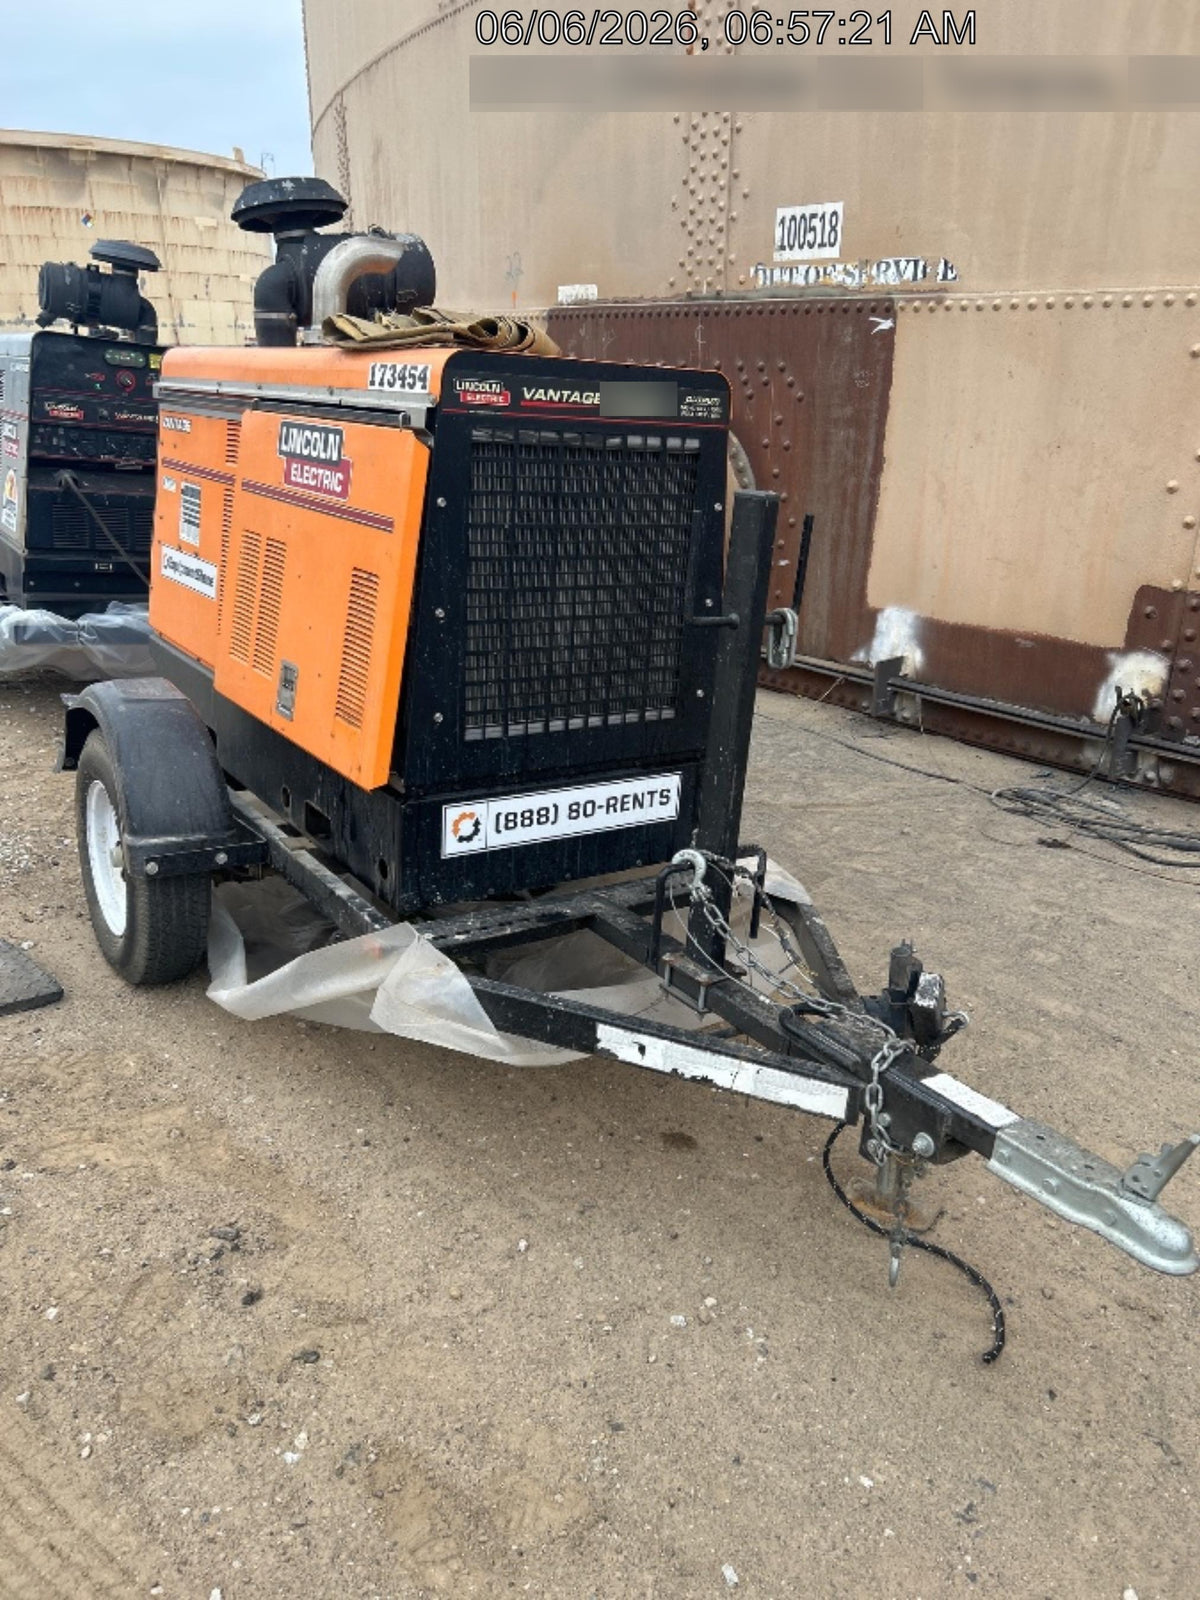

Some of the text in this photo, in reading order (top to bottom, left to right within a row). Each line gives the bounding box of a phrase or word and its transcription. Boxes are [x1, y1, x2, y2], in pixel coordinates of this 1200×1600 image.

[777, 209, 840, 252] 100518
[369, 362, 429, 390] 173454
[455, 380, 501, 394] LINCOLN
[280, 425, 341, 462] LINCOLN
[290, 462, 344, 493] ELECTRIC
[494, 788, 671, 834] (888) 80-RENTS
